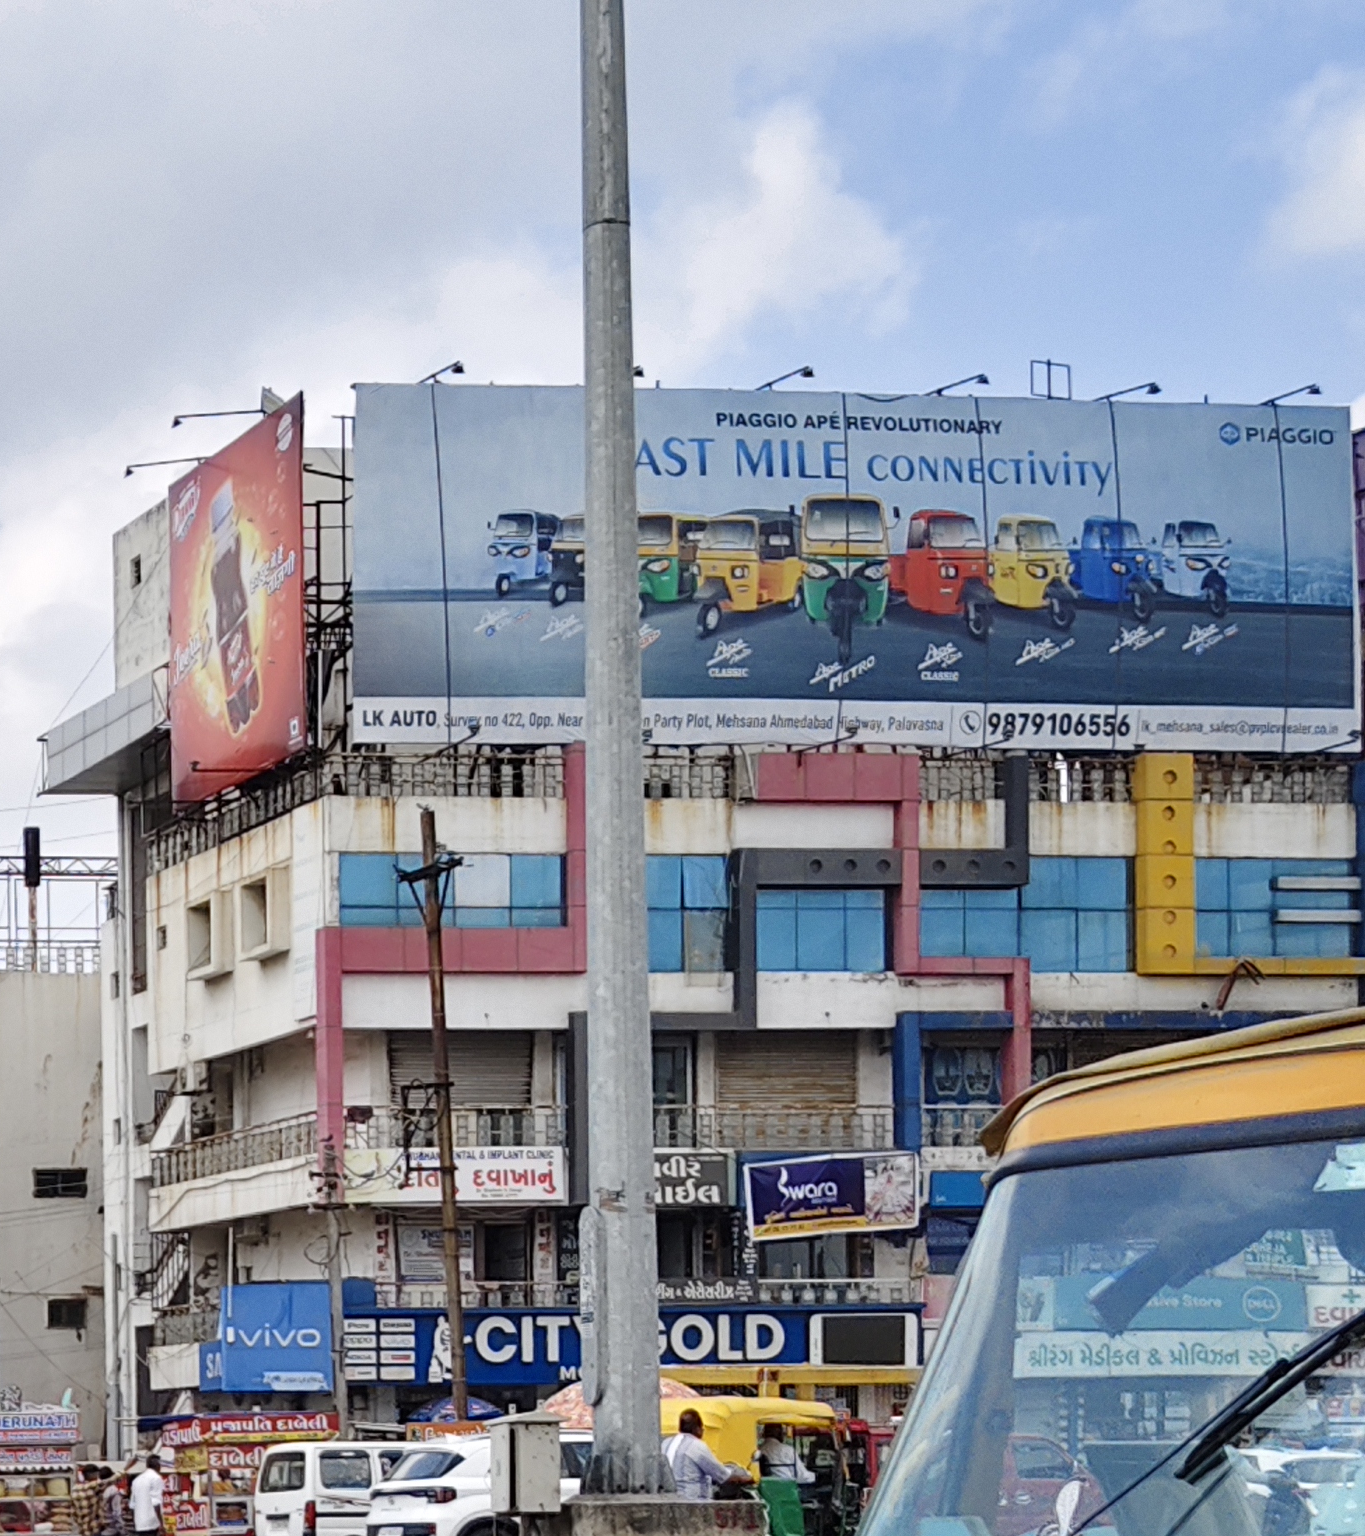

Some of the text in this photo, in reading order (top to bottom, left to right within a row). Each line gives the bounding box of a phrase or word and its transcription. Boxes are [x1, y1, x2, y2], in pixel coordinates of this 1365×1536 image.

[716, 411, 1002, 435] PIAGGIO APÉ REVOLUTIONARY
[1245, 426, 1335, 446] PIAGGIO
[634, 437, 715, 477] AST
[736, 438, 847, 480] MILE
[708, 667, 750, 679] CLASSIC
[920, 671, 960, 682] CLASSIC
[362, 710, 384, 727] LK
[485, 717, 499, 728] no
[501, 713, 525, 730] 422,
[529, 714, 554, 731] Opp.
[558, 714, 583, 728] Near
[654, 715, 683, 731] Party
[686, 715, 712, 729] Plot,
[716, 715, 767, 729] Mehsana
[769, 714, 833, 730] Ahmedabad
[888, 717, 944, 732] Palavasna
[987, 713, 1131, 737] 9879106556
[487, 1151, 524, 1160] IMPLANT
[526, 1151, 555, 1160] CLINIC
[472, 1160, 557, 1194] દવાખાનું
[777, 1166, 838, 1207] Swara
[238, 1322, 321, 1348] vivo
[658, 1313, 786, 1362] OLD
[1079, 1342, 1141, 1367] મેડીકલ
[1146, 1349, 1163, 1366] &
[1169, 1342, 1240, 1367] પ્રોવિઝન
[275, 1414, 329, 1432] દાબેલી
